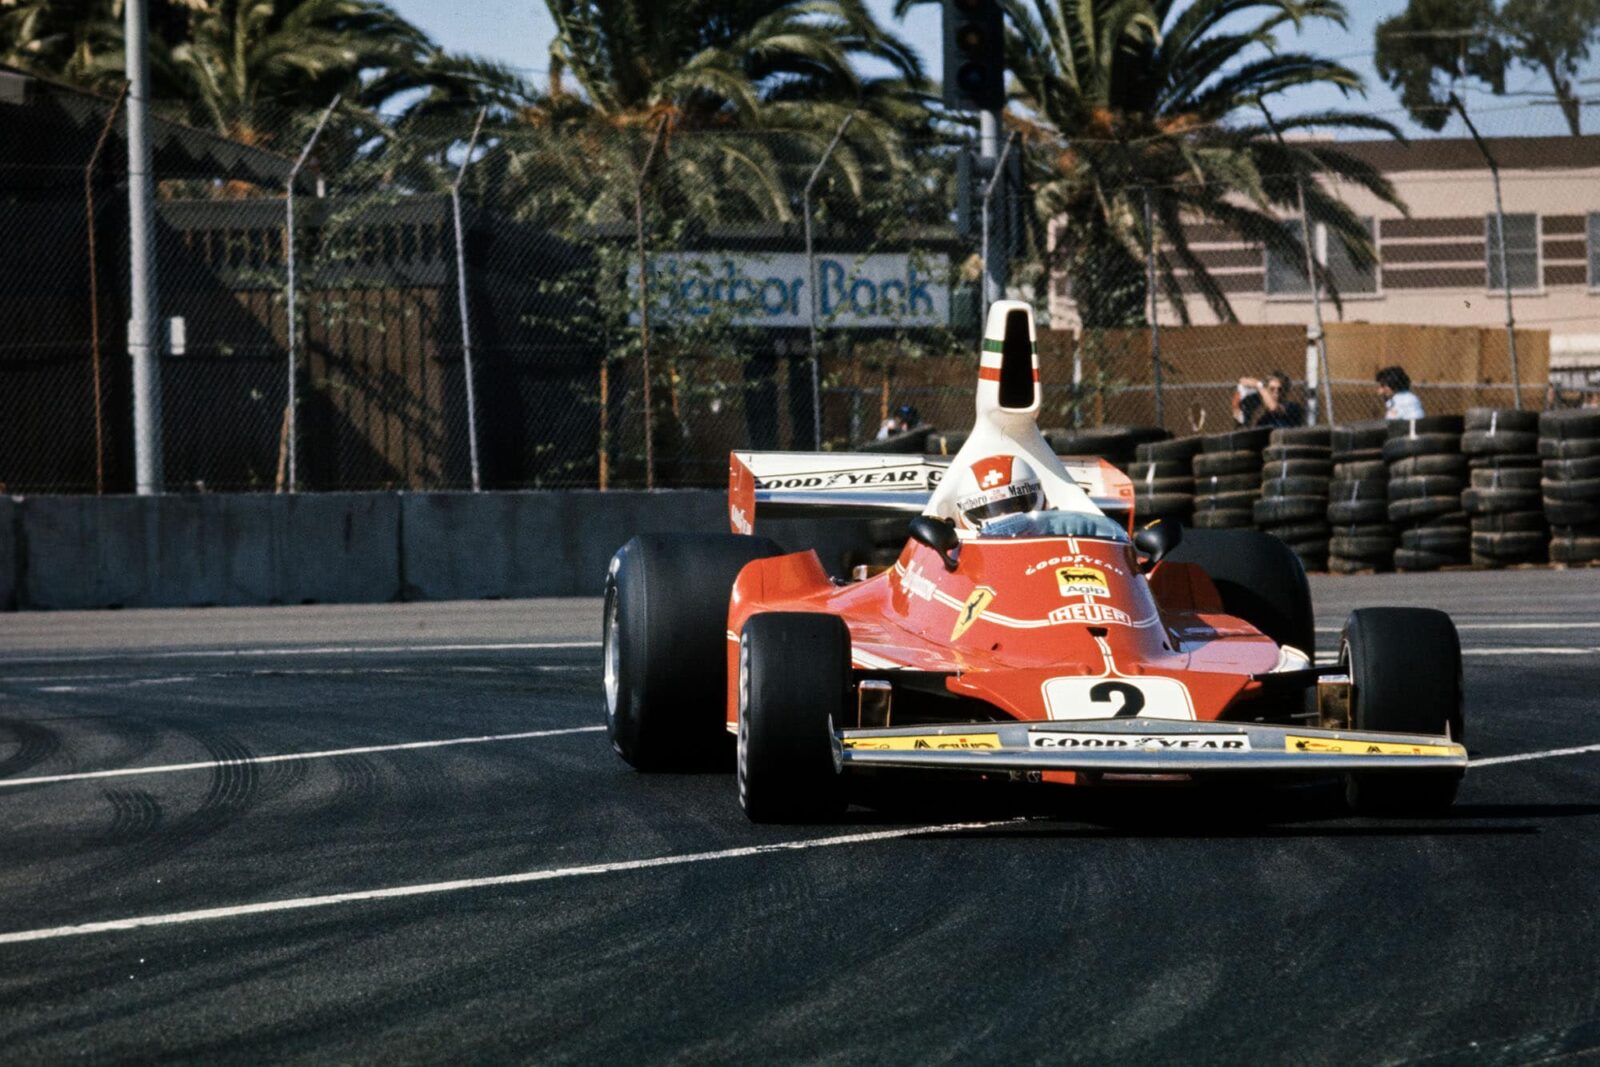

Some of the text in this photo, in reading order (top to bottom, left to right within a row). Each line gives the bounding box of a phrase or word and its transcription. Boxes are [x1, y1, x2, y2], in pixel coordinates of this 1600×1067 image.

[819, 259, 934, 316] Bank
[849, 470, 918, 485] YEAR
[1067, 586, 1105, 595] Agip
[1054, 603, 1128, 623] HEUER
[1090, 681, 1145, 718] 2
[1034, 737, 1245, 749] GOOD YEAR
